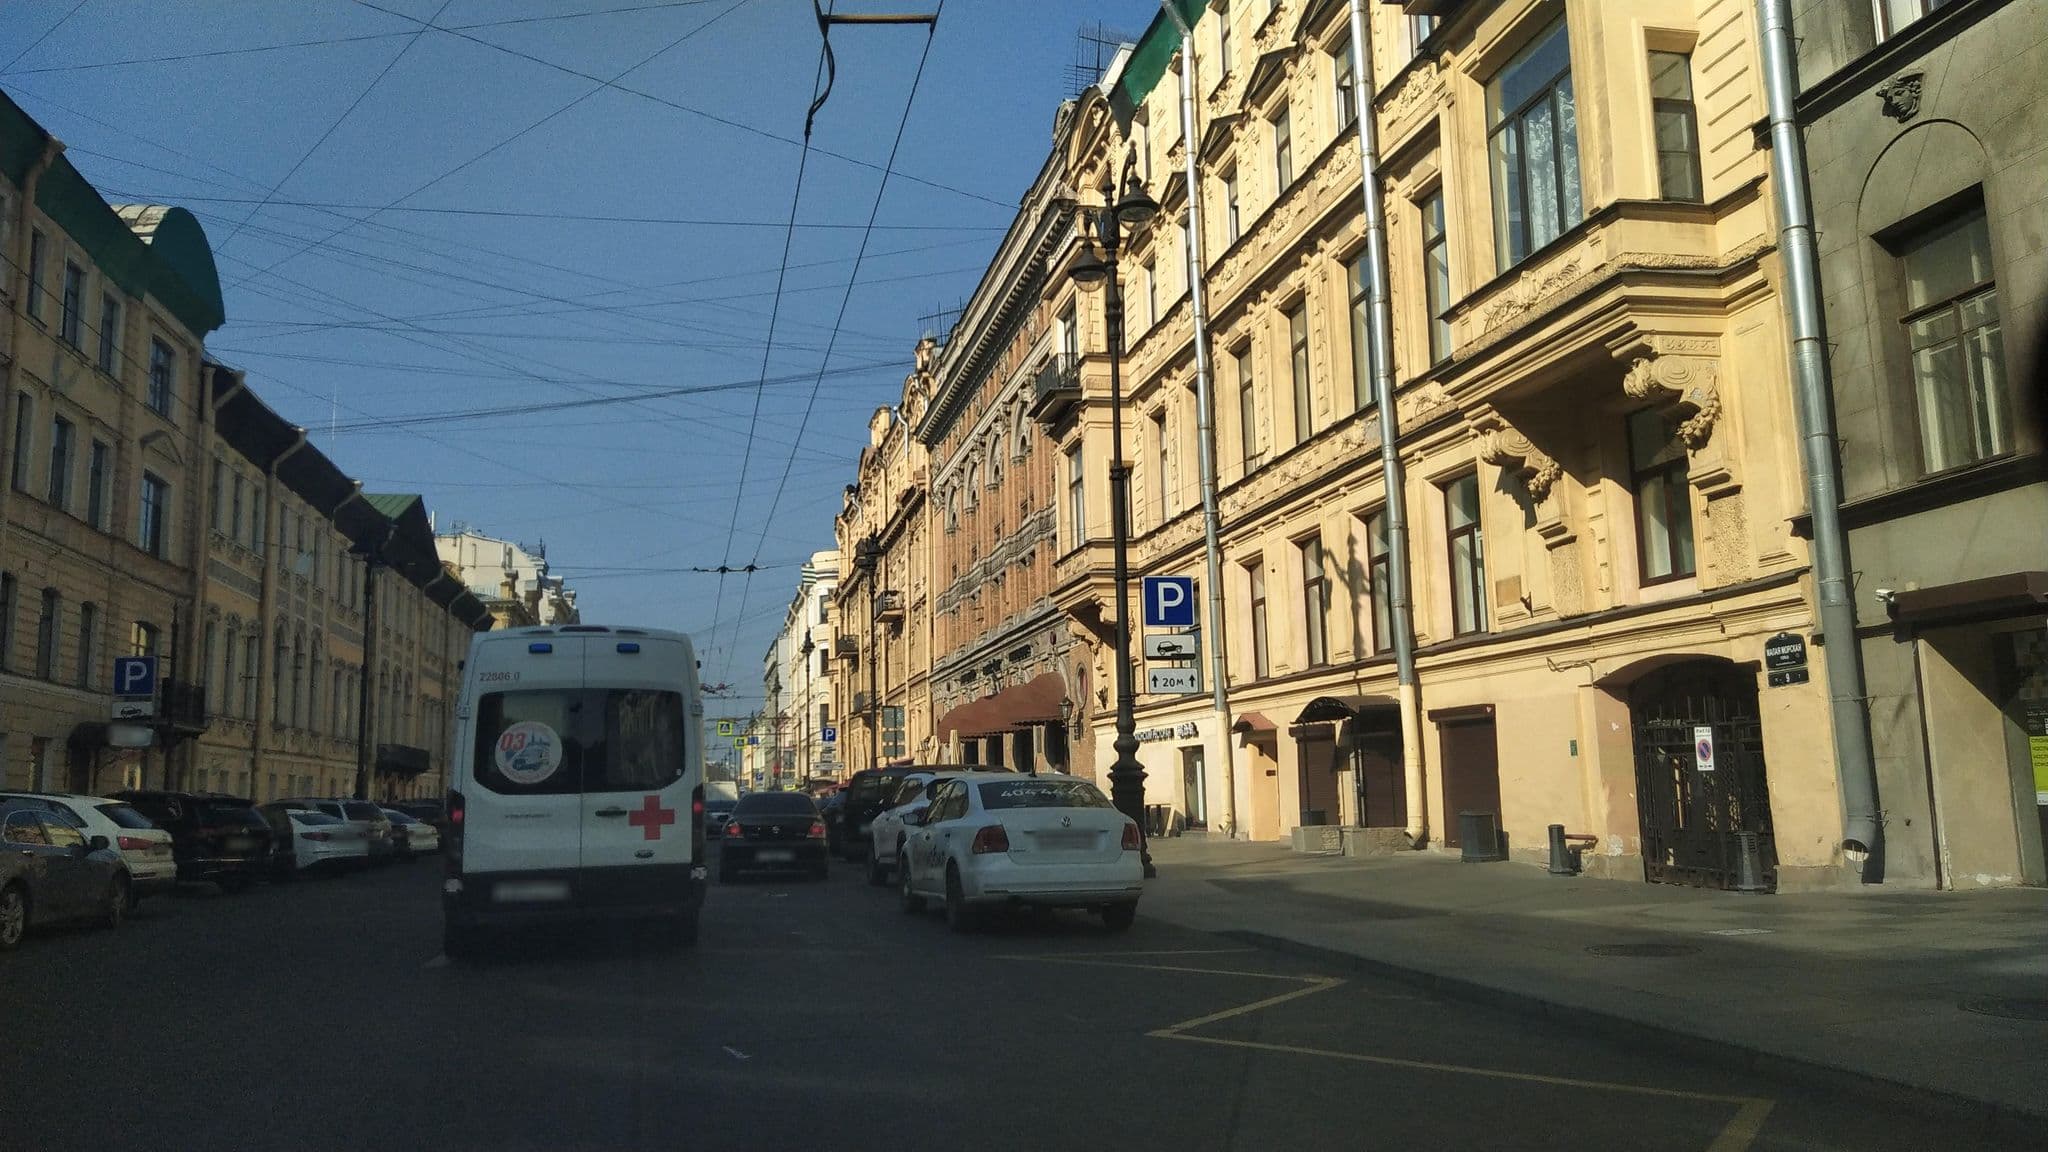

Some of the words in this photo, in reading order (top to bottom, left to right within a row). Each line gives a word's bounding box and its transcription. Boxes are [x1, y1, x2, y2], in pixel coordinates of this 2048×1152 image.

[1157, 582, 1184, 621] P
[124, 661, 147, 691] P
[500, 732, 526, 751] 03
[825, 729, 834, 740] P
